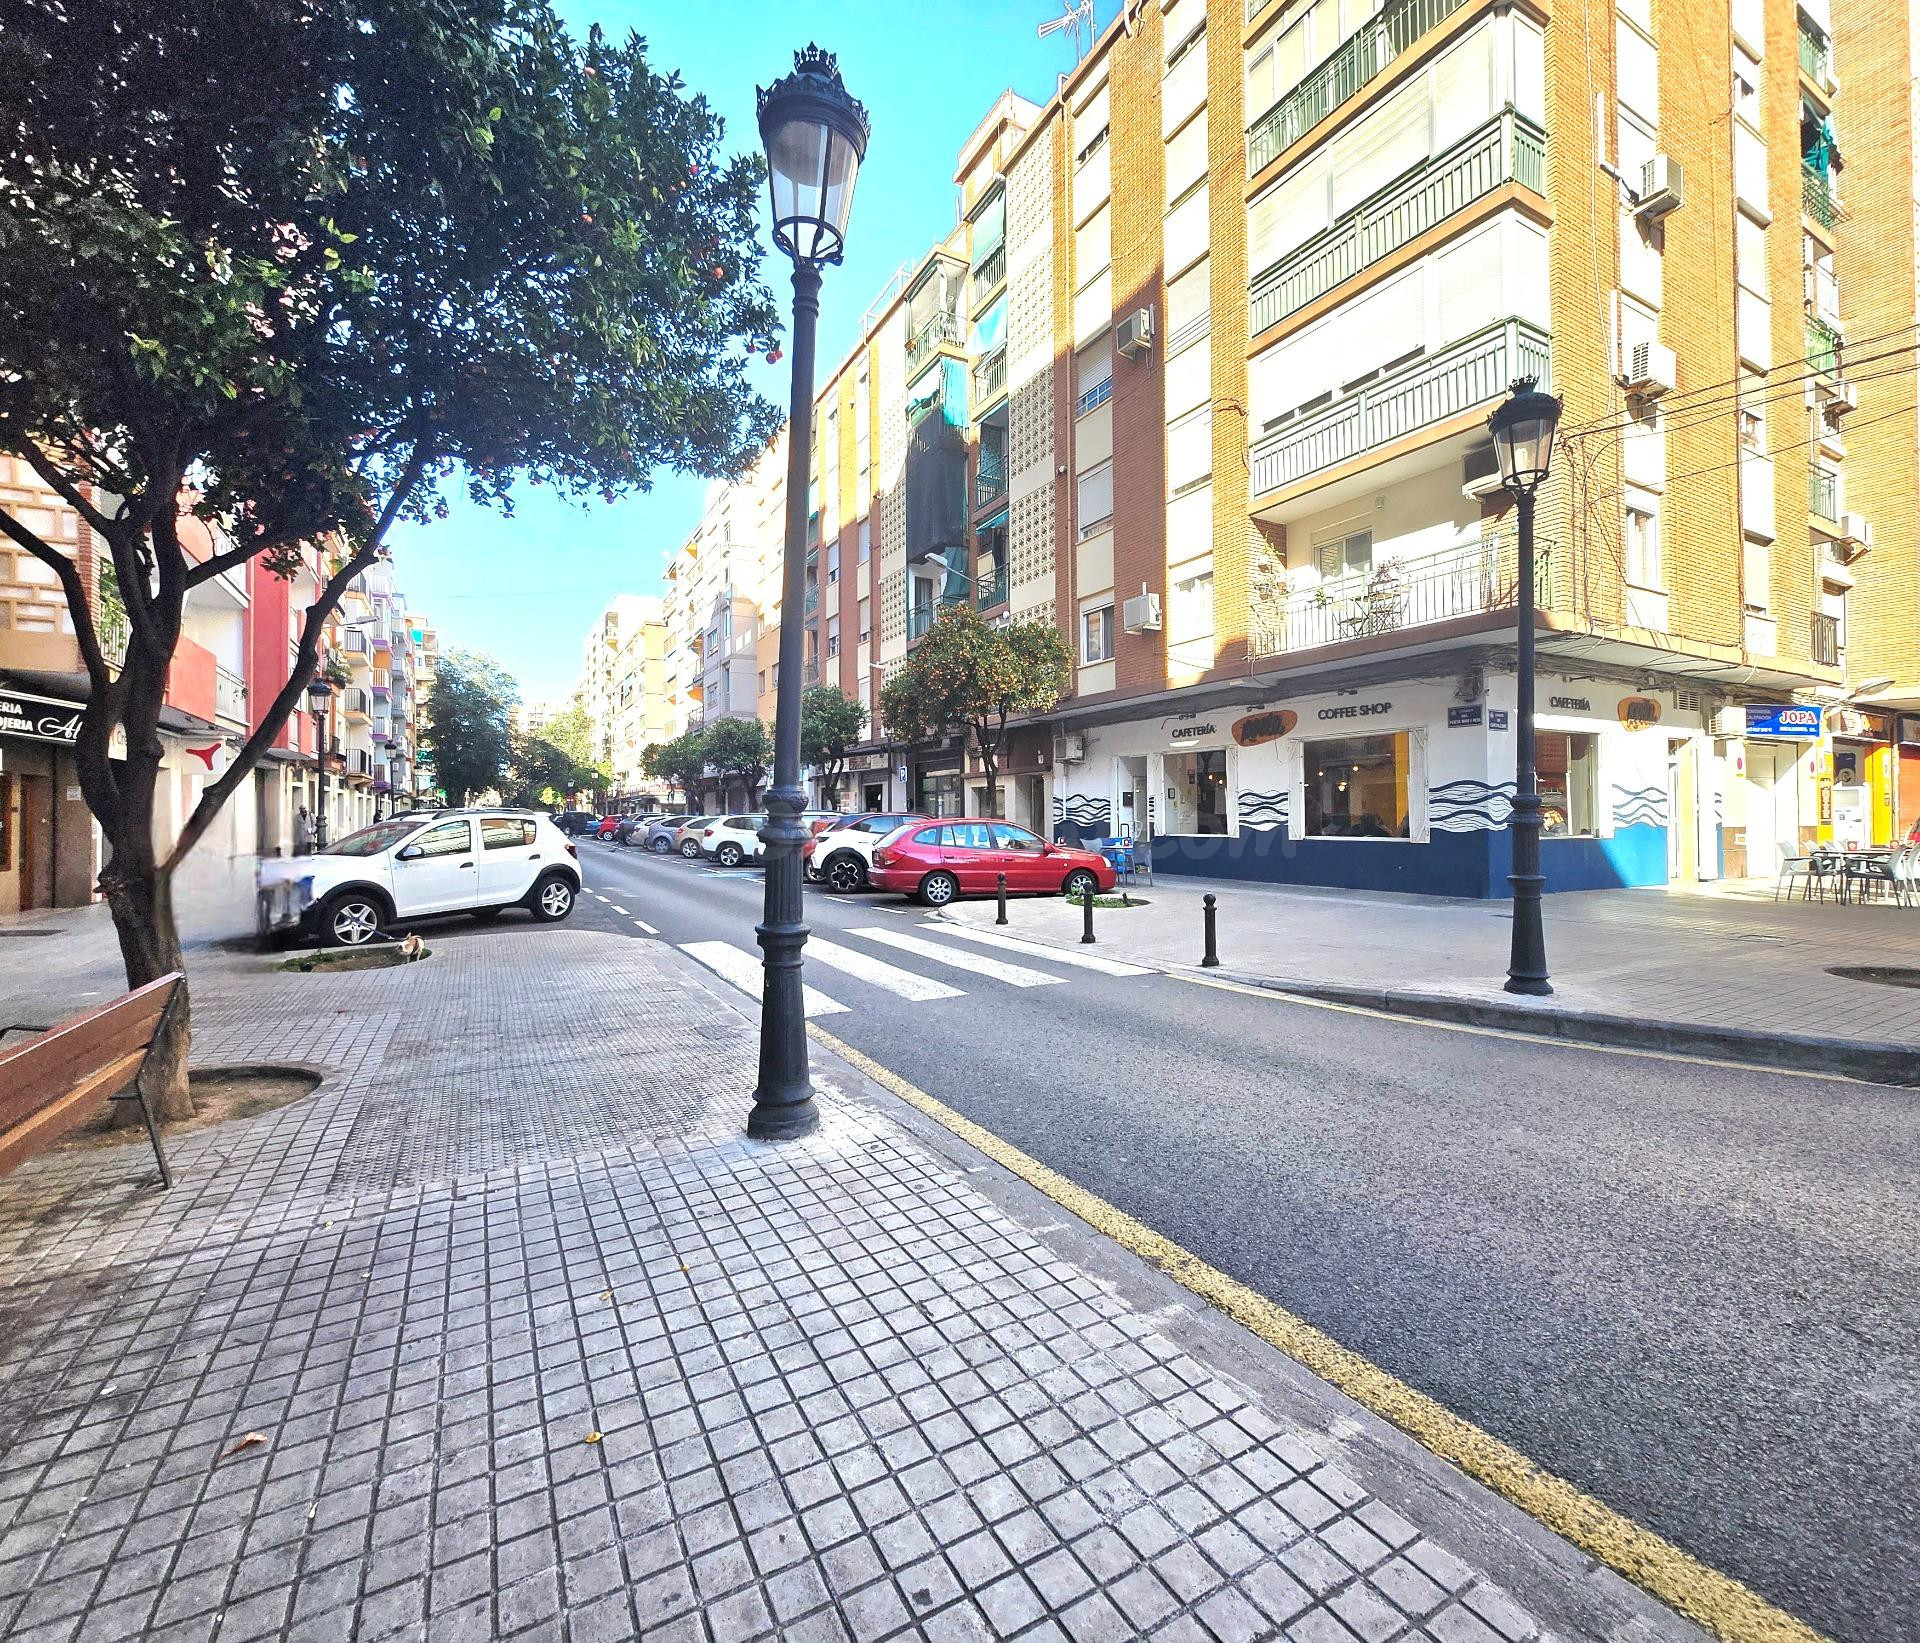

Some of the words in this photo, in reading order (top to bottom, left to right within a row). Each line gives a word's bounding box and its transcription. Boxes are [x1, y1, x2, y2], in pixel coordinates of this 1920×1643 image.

[1317, 706, 1358, 720] COFFEE
[1359, 702, 1392, 716] SHOP
[1551, 697, 1591, 711] CAFETERÍA
[1779, 710, 1818, 725] JOPA
[1172, 723, 1216, 738] CAFETERÍA
